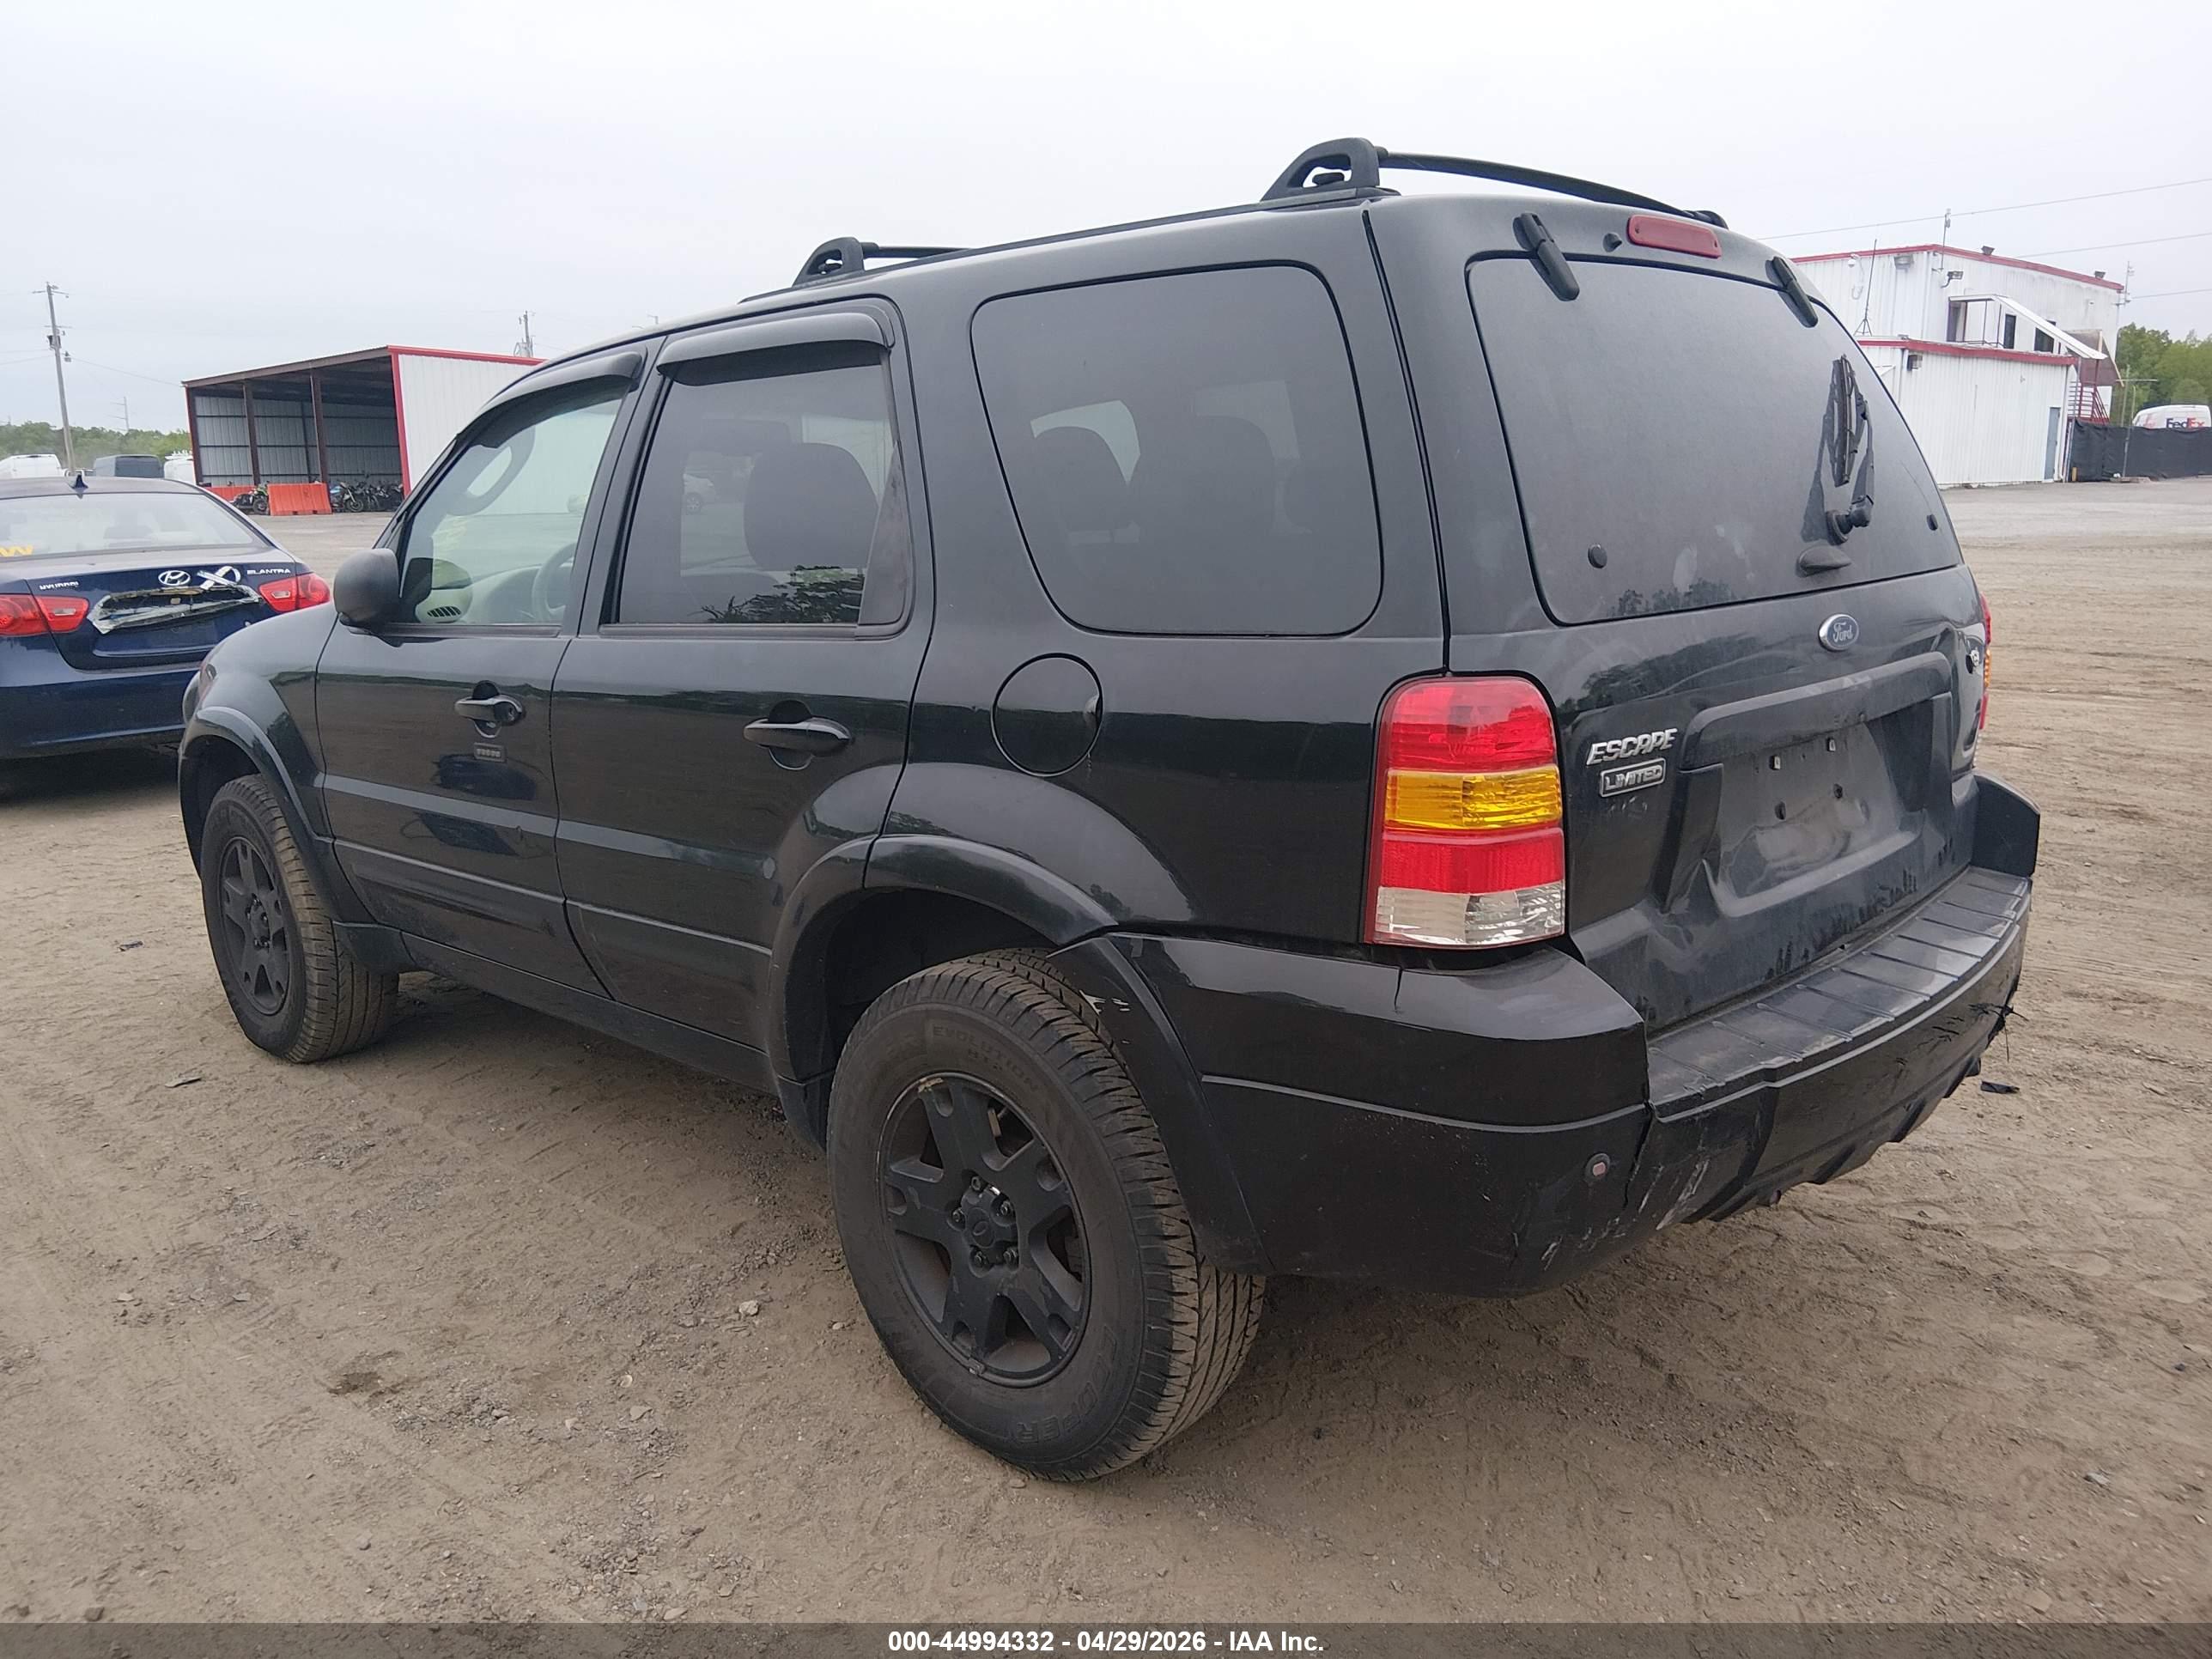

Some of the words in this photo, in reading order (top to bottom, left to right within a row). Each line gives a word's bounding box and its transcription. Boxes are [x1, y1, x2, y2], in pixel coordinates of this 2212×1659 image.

[2166, 416, 2205, 428] FedEx
[1832, 622, 1854, 642] Ford
[1586, 728, 1678, 766] ESCAPE
[1605, 763, 1663, 791] LIMITED
[1015, 1325, 1119, 1444] COOPER
